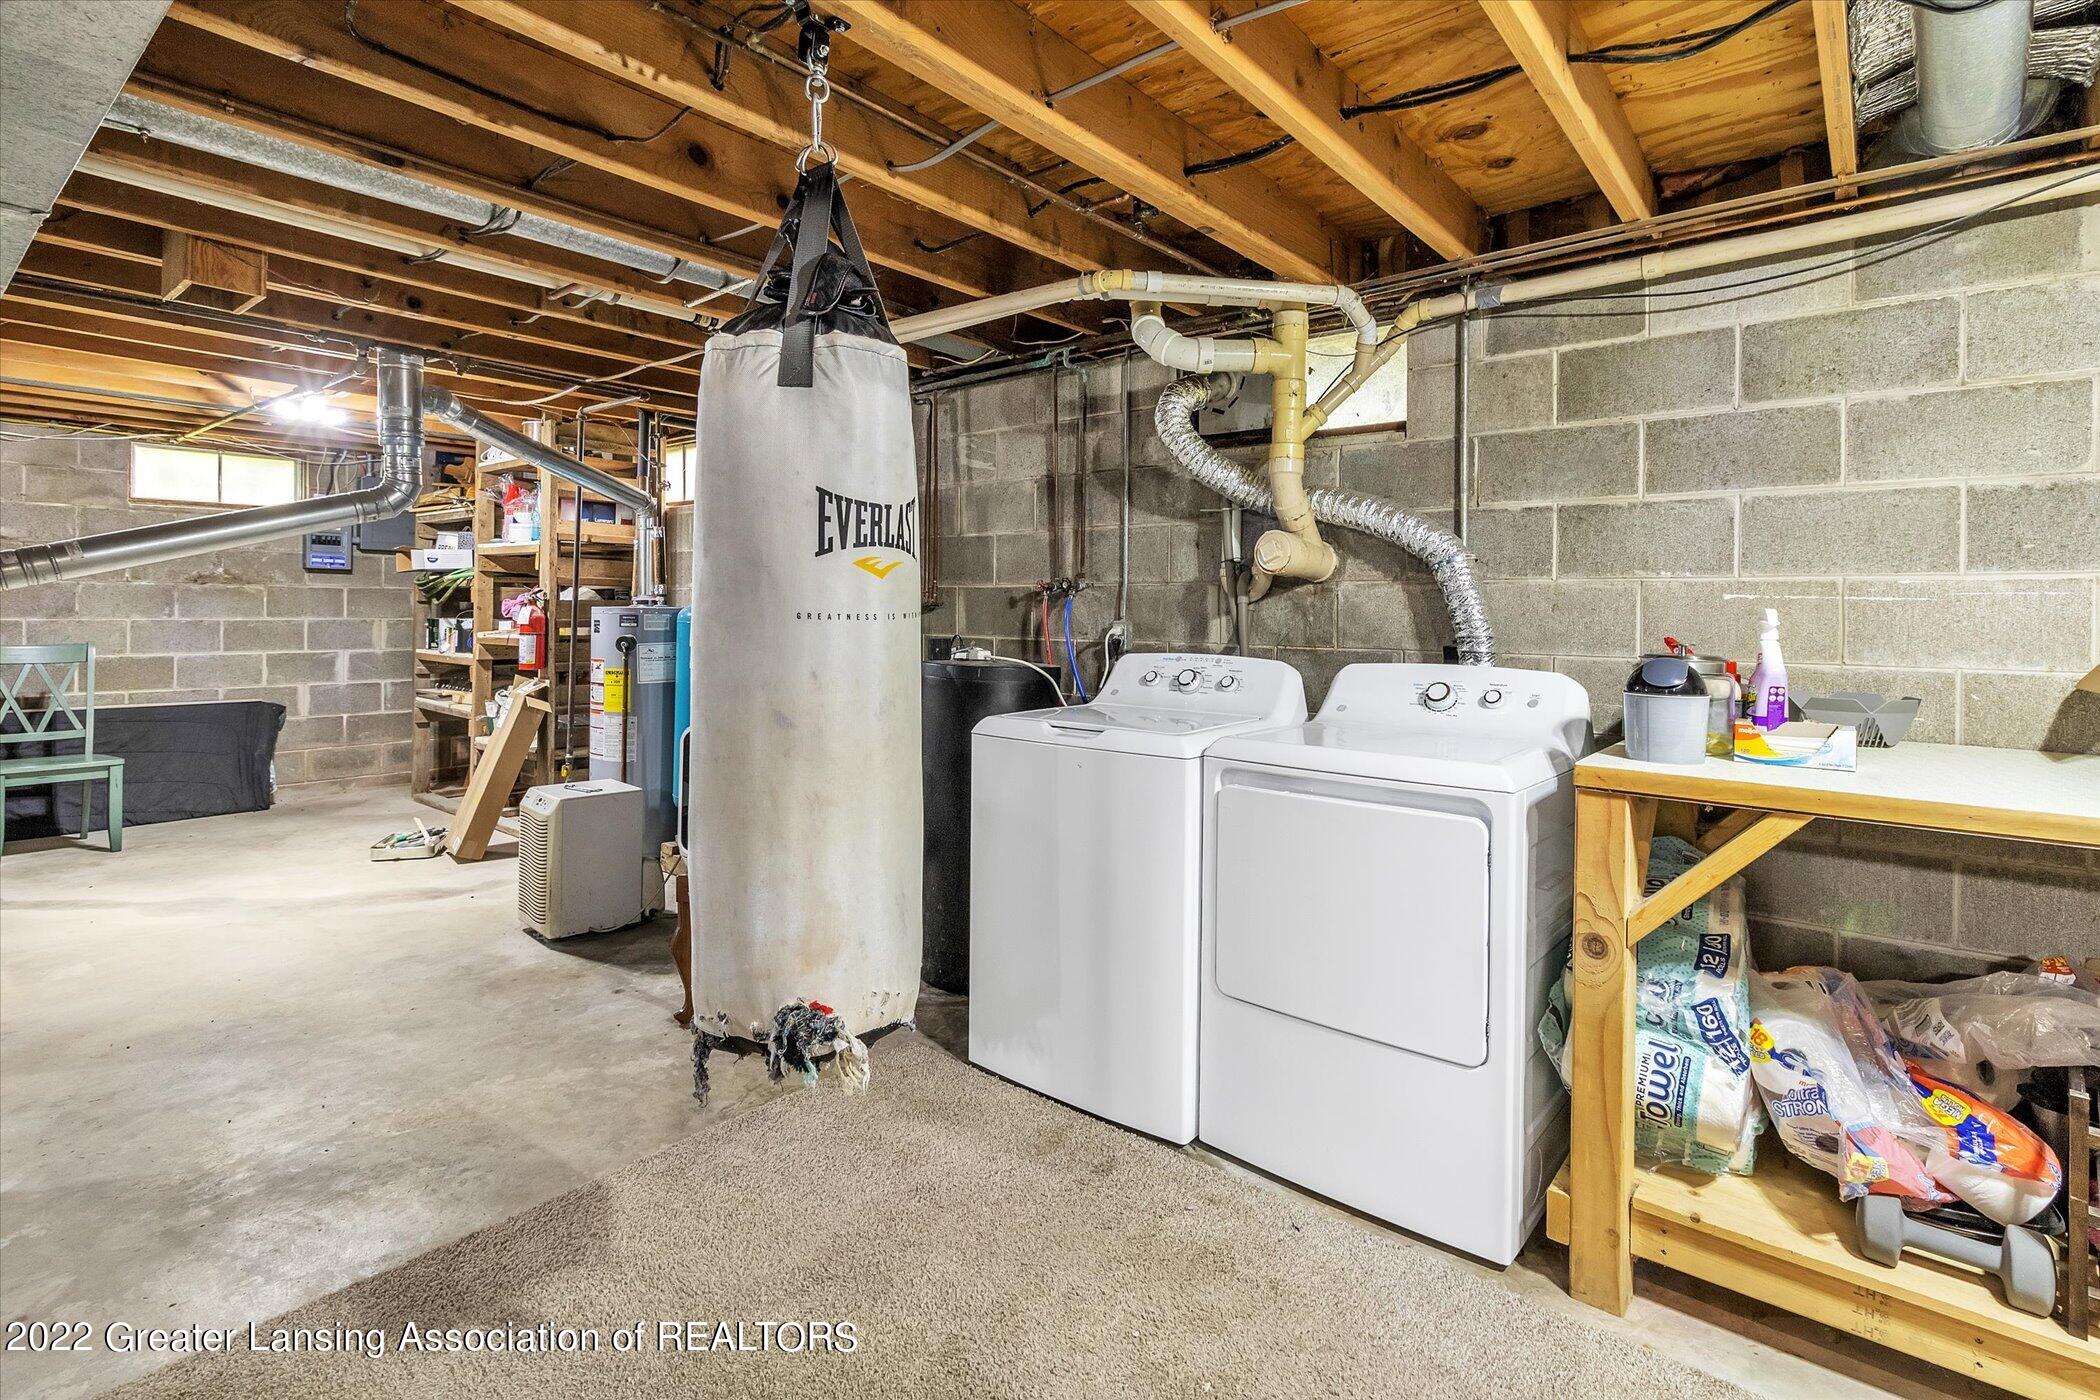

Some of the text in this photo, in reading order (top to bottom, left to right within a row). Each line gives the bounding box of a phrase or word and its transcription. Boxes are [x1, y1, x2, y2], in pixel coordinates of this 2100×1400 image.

[815, 486, 917, 562] EVERLAST
[796, 612, 878, 621] GREATNESS
[887, 613, 896, 621] IS
[1700, 954, 1719, 968] 12
[1696, 1004, 1722, 1041] 160
[1751, 1028, 1768, 1046] 18
[1636, 1056, 1650, 1106] PREMIUM
[1640, 1040, 1681, 1129] Towel
[1773, 1100, 1829, 1118] STRON
